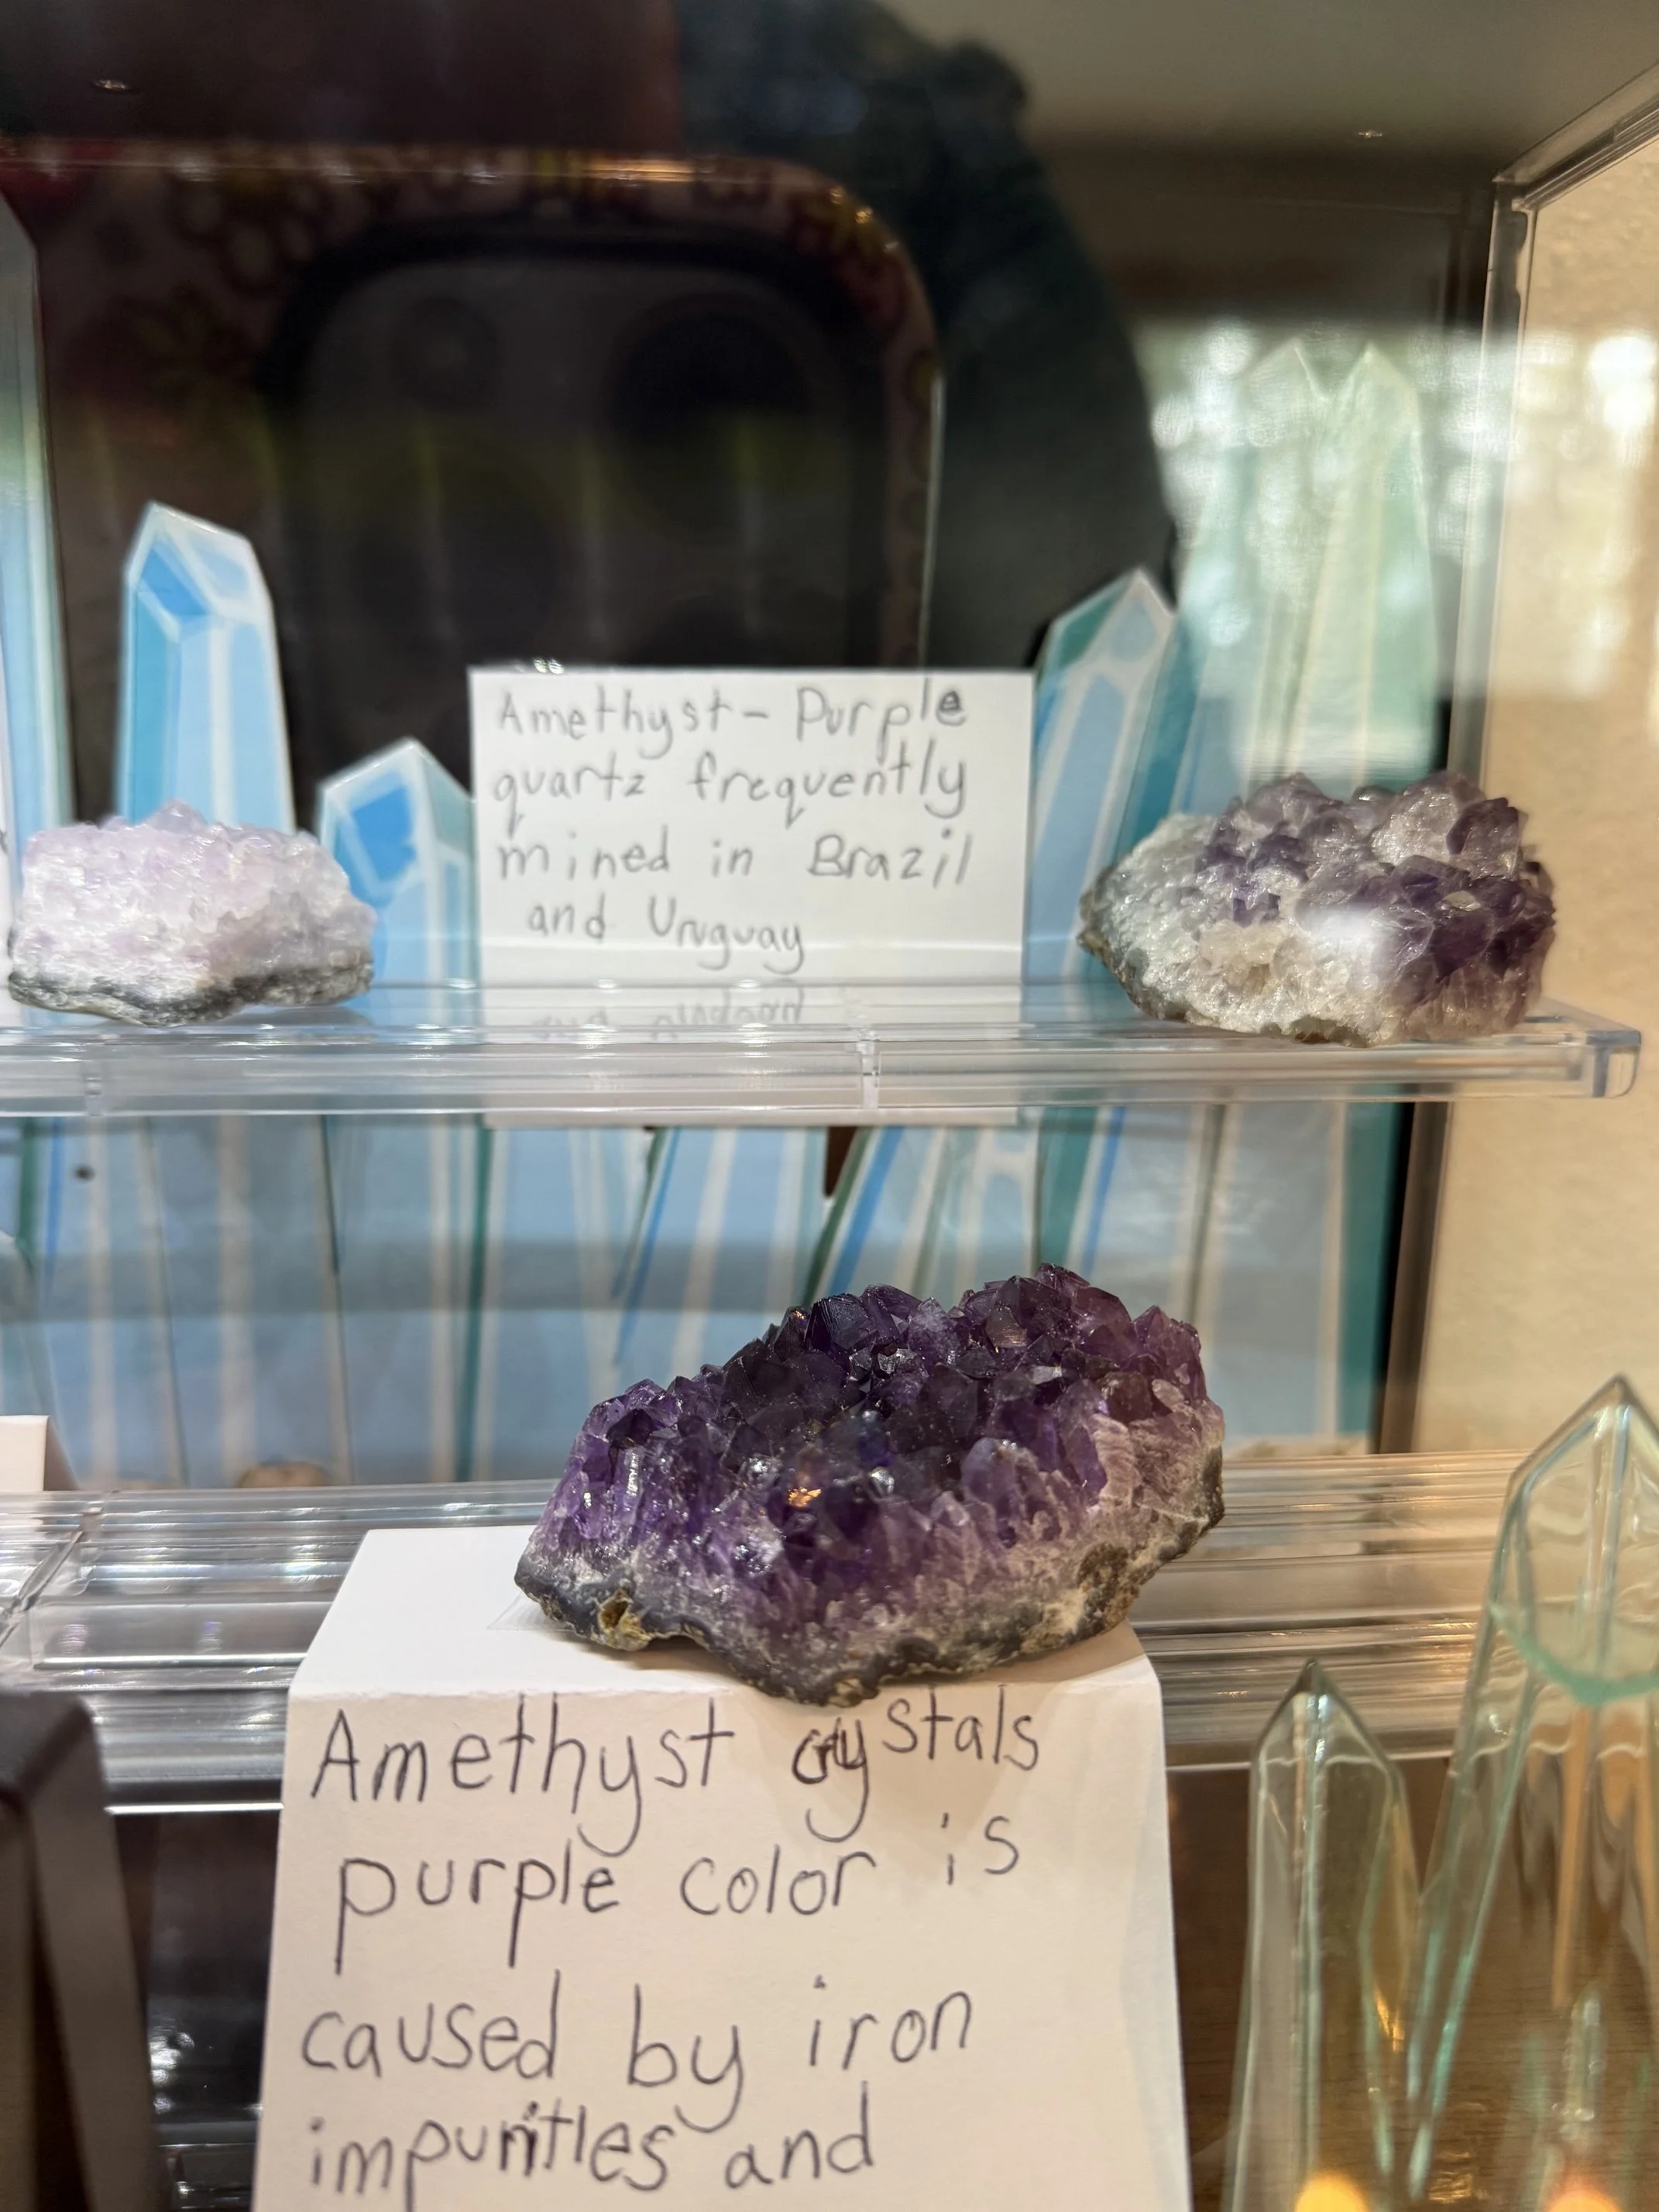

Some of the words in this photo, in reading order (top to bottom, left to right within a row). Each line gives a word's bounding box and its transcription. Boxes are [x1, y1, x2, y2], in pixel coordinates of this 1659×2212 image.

[796, 678, 967, 764] Purple
[494, 750, 645, 840] quartz
[689, 737, 967, 830] frequently
[497, 825, 671, 881] mined
[712, 839, 754, 878] in
[807, 827, 973, 888] Brazil
[527, 893, 606, 941] and
[647, 895, 805, 977] Uruguay
[309, 1692, 736, 1859] Amethyst
[334, 1838, 620, 1977] purple
[678, 1843, 878, 1918] color
[939, 1812, 1020, 1886] is
[300, 1968, 562, 2082] caused
[626, 1982, 745, 2135] by
[808, 1973, 973, 2073] iron
[723, 2080, 875, 2191] and
